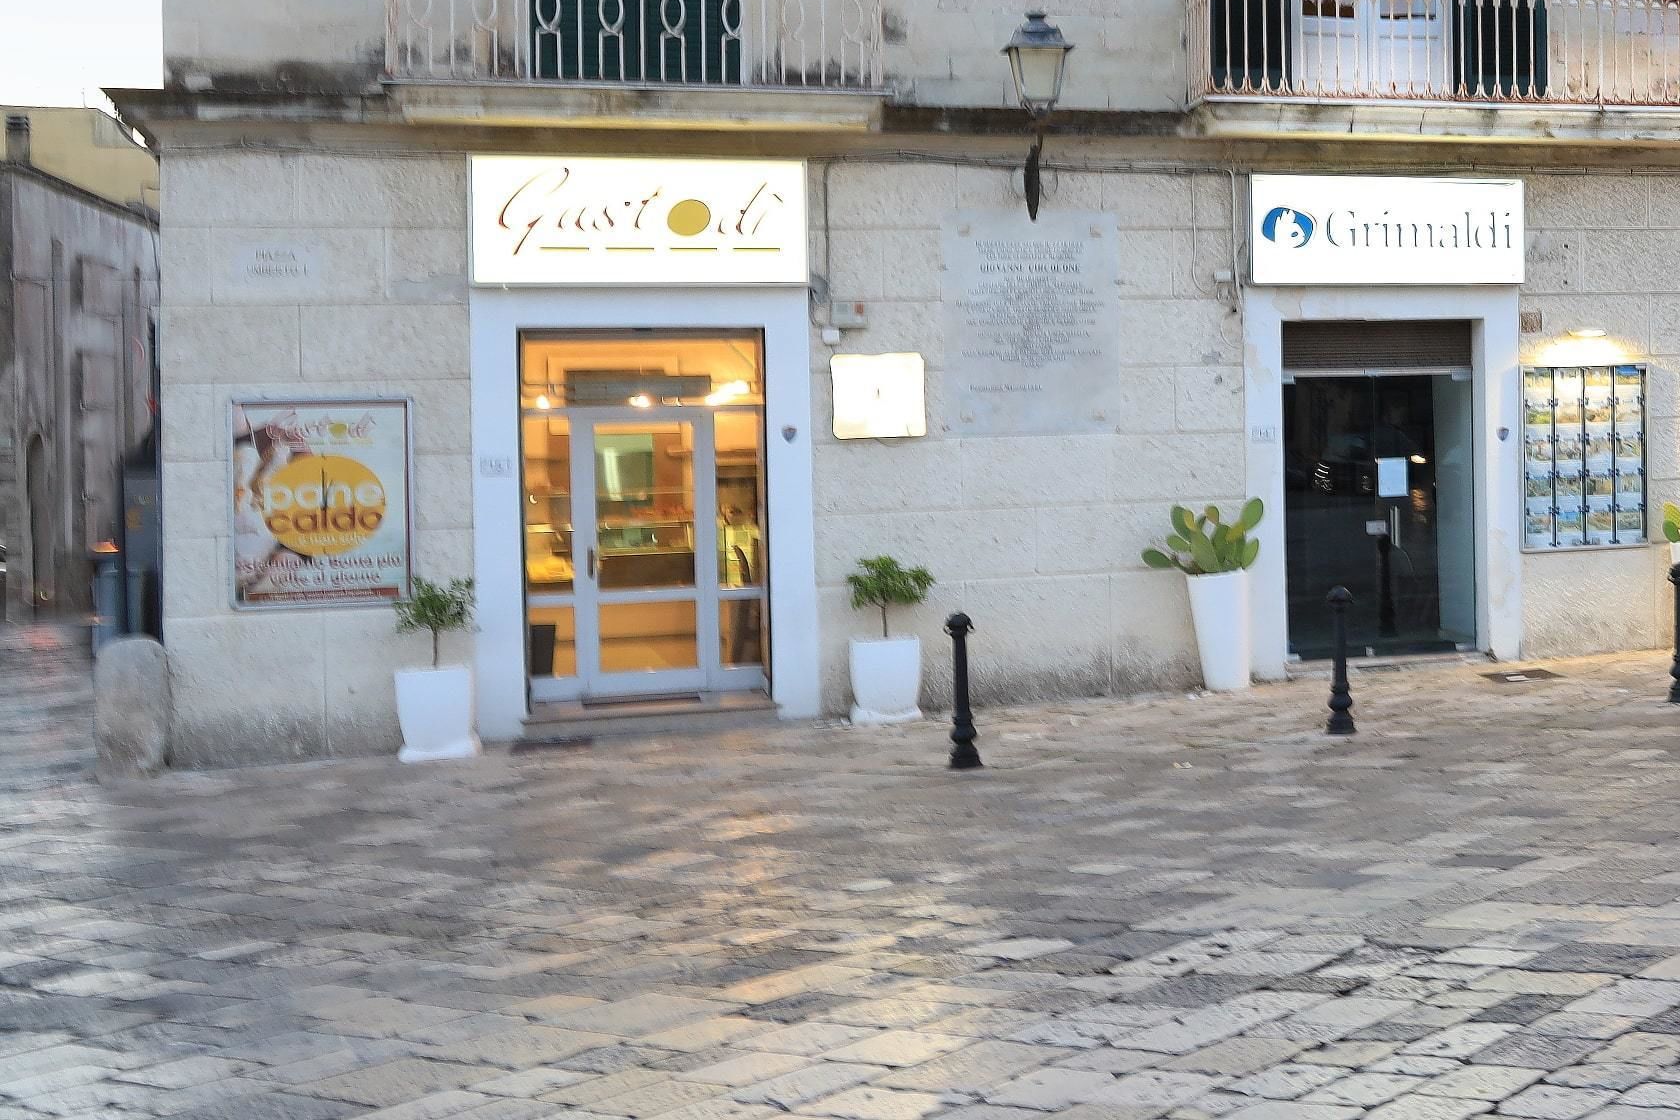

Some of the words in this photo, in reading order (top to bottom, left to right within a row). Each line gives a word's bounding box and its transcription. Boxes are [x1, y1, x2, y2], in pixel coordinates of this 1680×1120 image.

[1326, 210, 1513, 248] Grimaldi
[264, 480, 386, 515] pane
[266, 507, 383, 535] caldo
